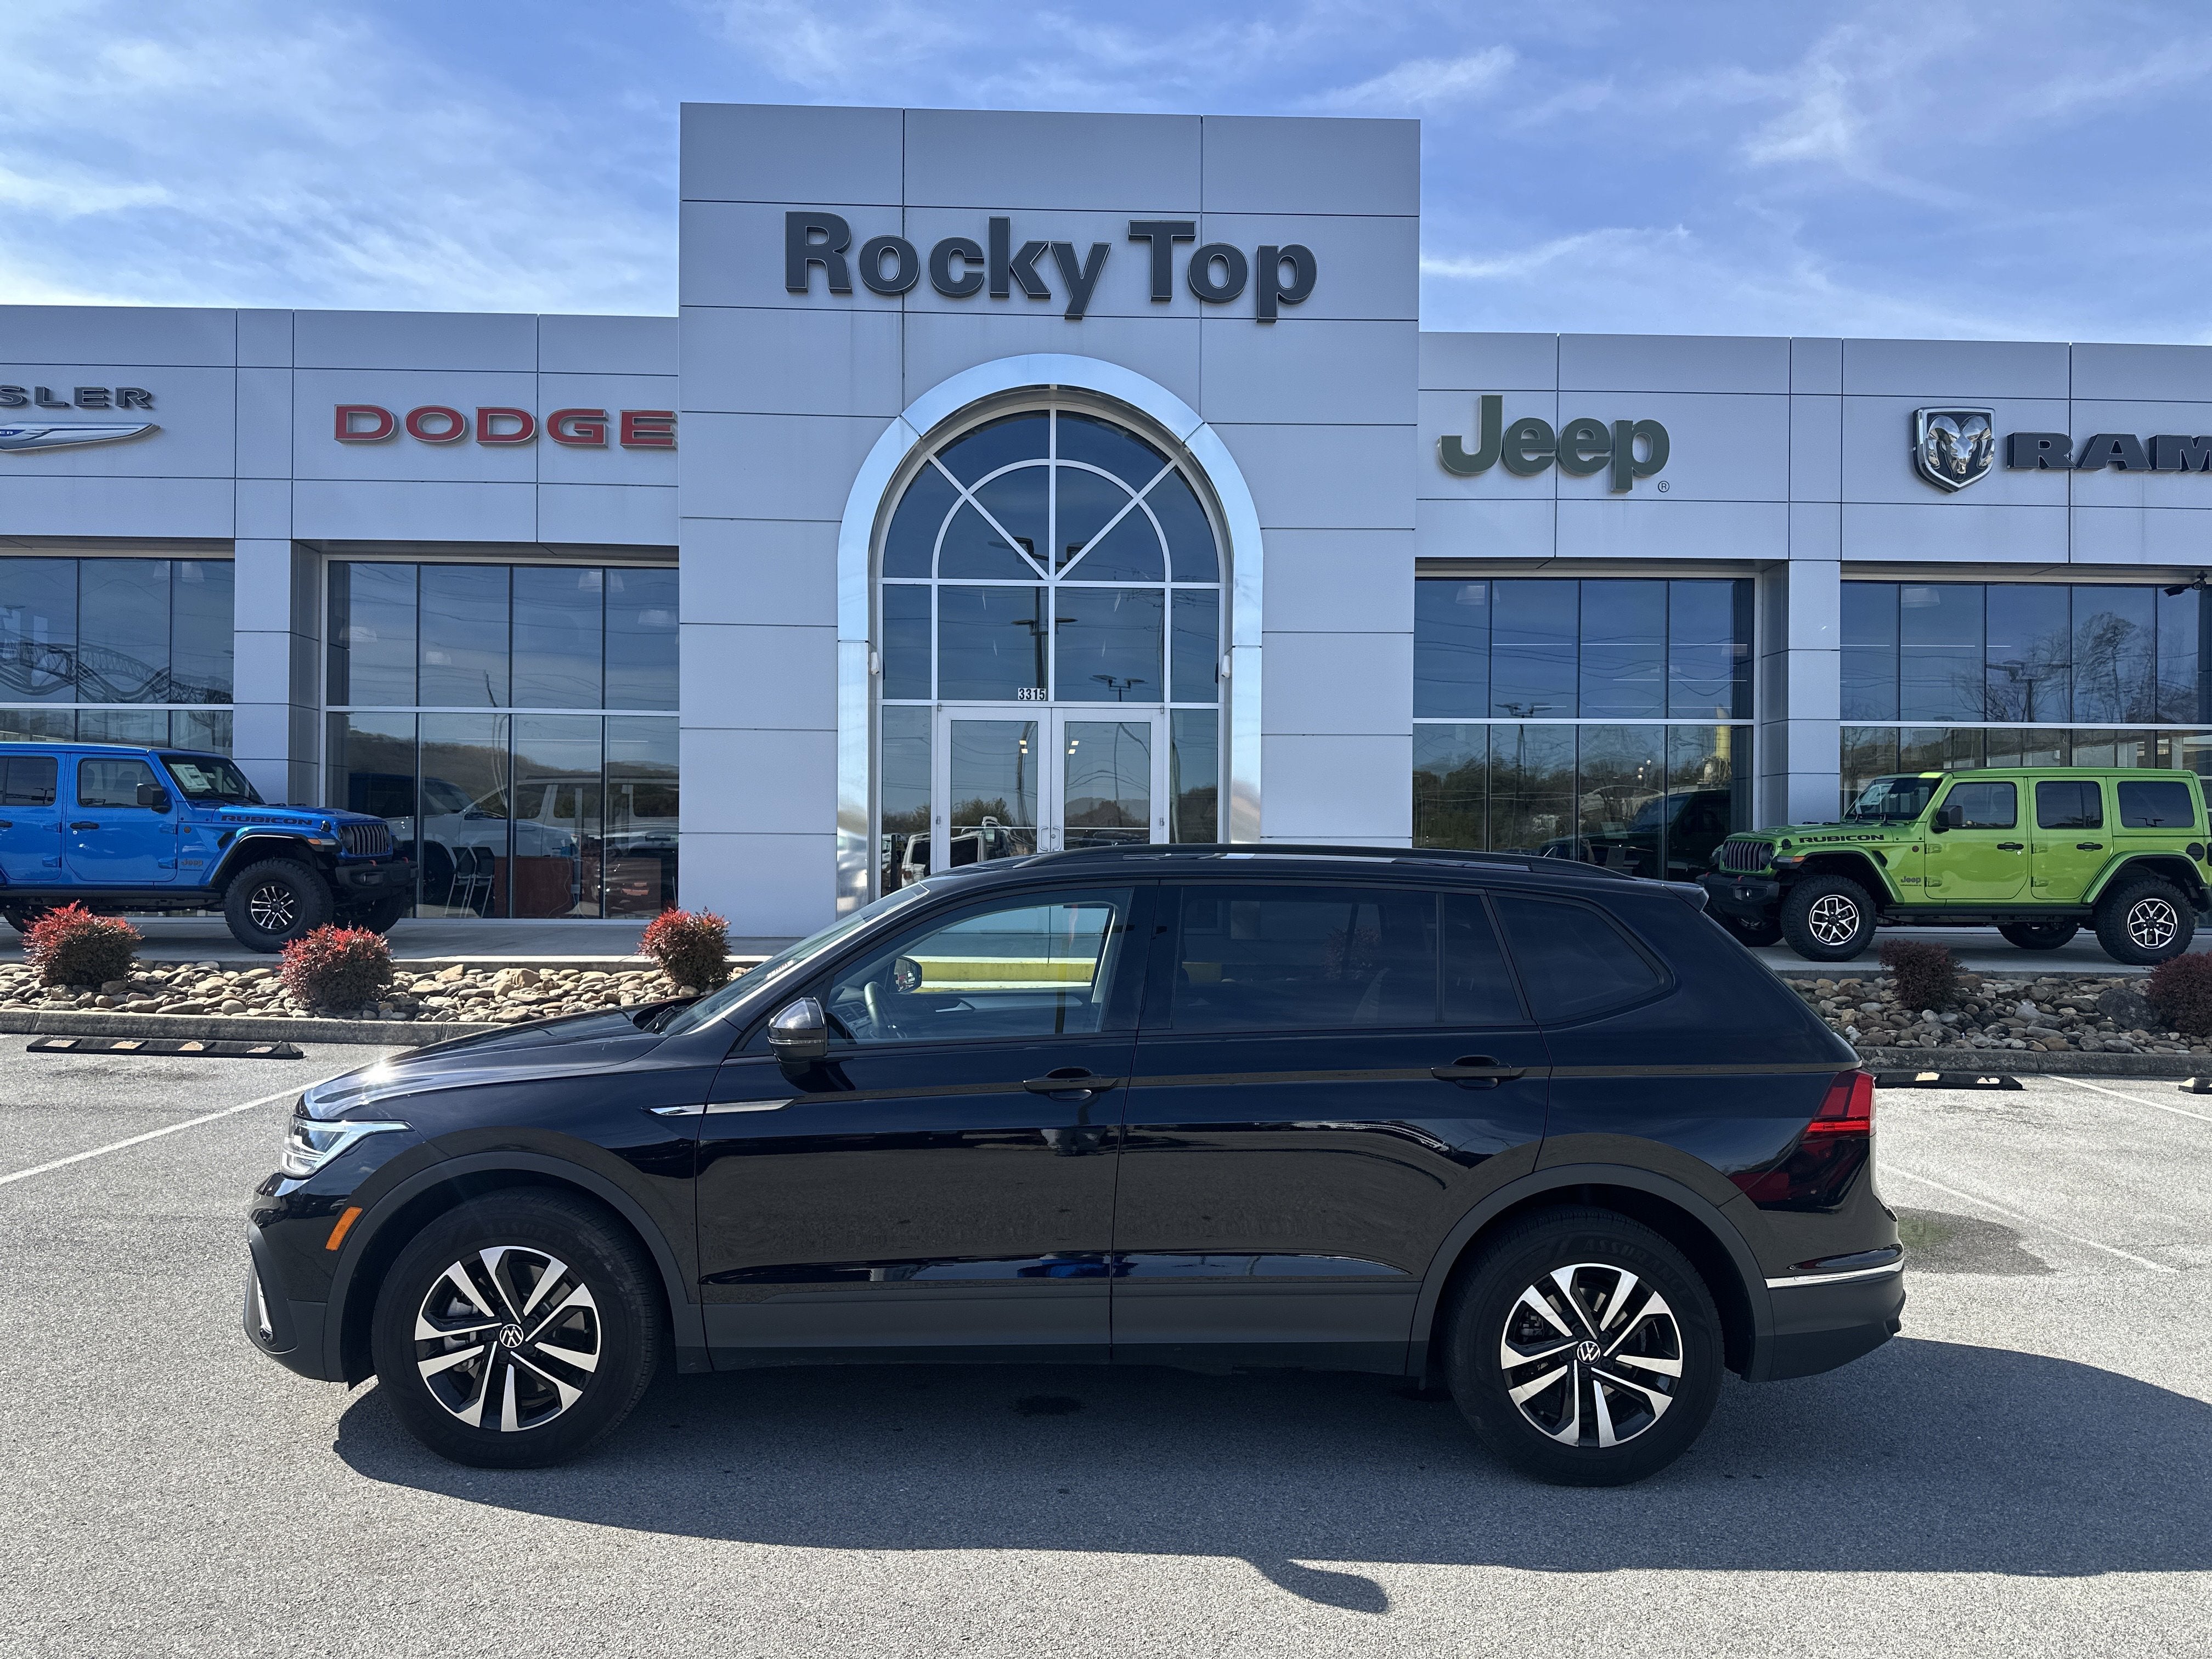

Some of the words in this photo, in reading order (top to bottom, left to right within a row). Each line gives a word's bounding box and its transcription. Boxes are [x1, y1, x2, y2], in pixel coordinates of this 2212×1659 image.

[785, 211, 1111, 320] Rocky
[1128, 220, 1318, 323] Top
[334, 404, 677, 449] DODGE
[1438, 394, 1671, 493] Jeep
[2007, 432, 2212, 472] RAM
[1019, 688, 1045, 699] 3315
[221, 815, 313, 825] RUBICON
[1799, 834, 1884, 843] RUBICON
[1900, 876, 1922, 884] Jeep
